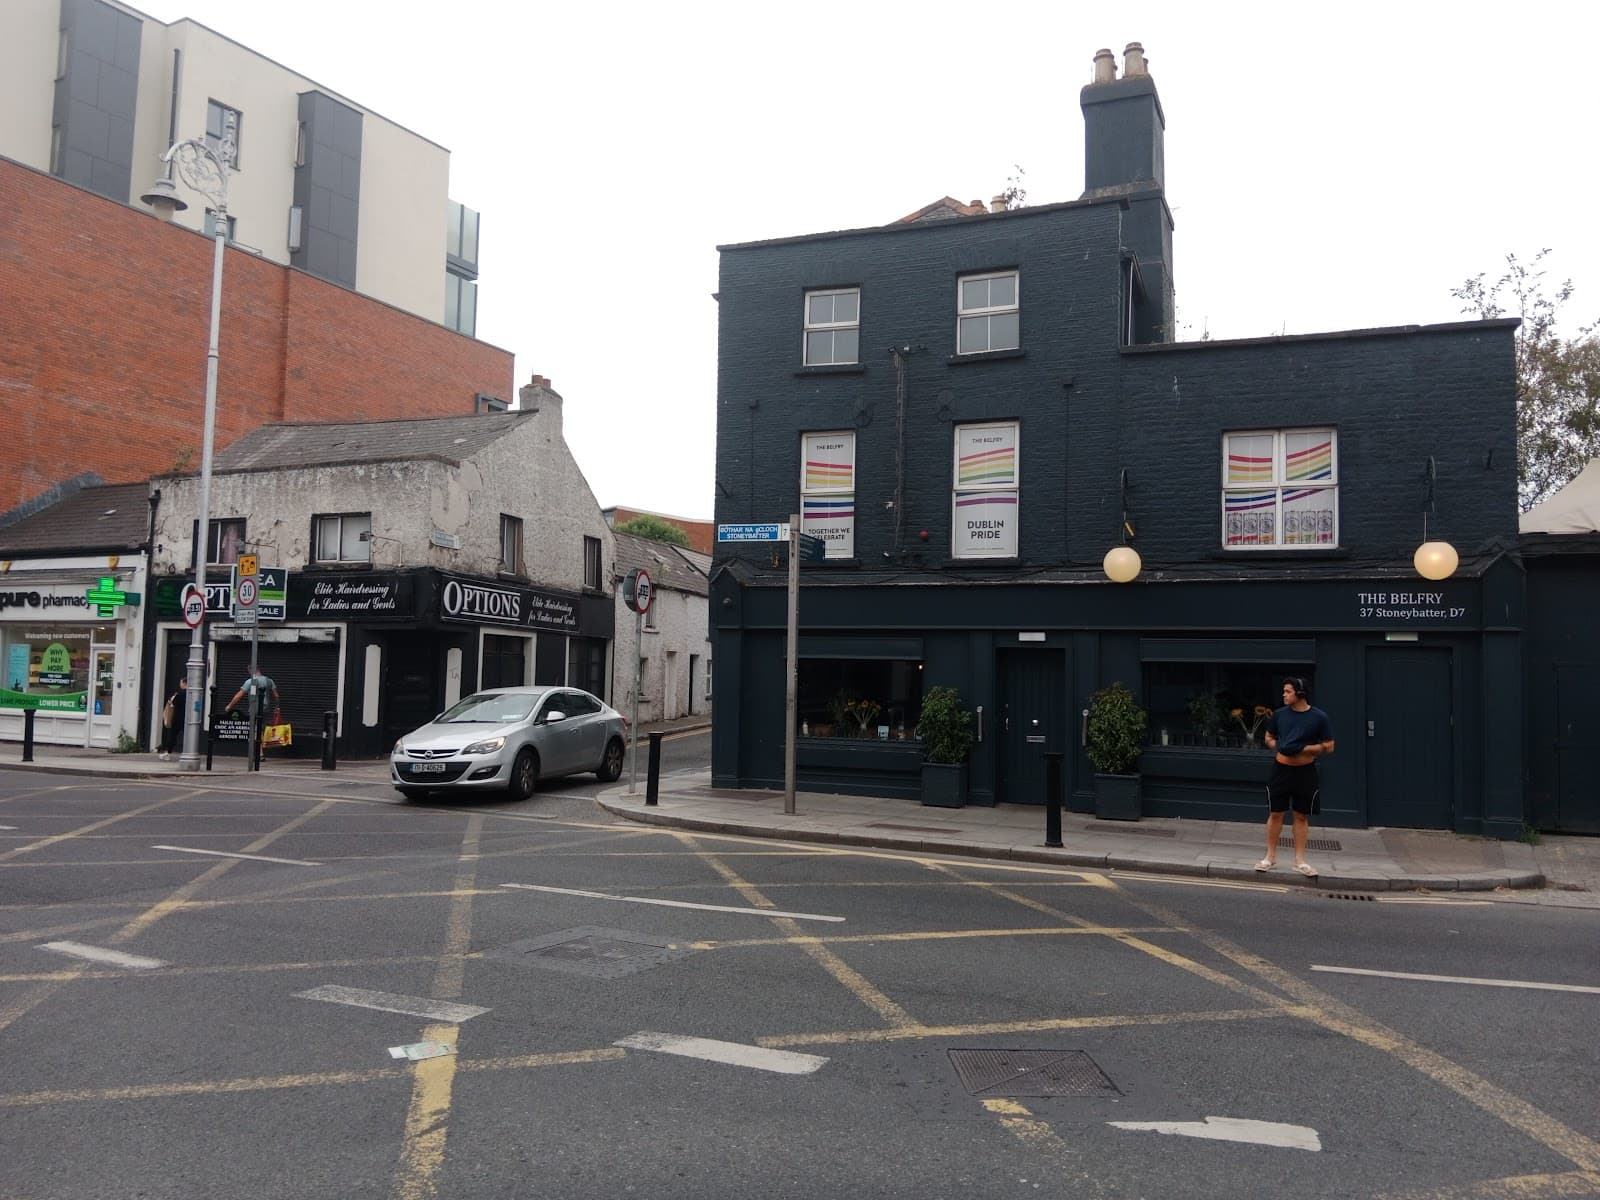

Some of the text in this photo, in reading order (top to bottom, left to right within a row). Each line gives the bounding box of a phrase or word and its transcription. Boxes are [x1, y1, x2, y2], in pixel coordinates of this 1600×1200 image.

[967, 520, 1004, 529] DUBLIN
[971, 530, 1000, 539] PRIDE
[243, 585, 252, 596] 30
[314, 582, 389, 598] Elite Hairdressing
[0, 591, 40, 611] pure
[443, 581, 520, 617] OPTIONS
[1358, 593, 1443, 604] THE BELFRY
[307, 597, 396, 615] for Ladies and Gents
[1360, 607, 1465, 619] 37 Stoneybatter, D7
